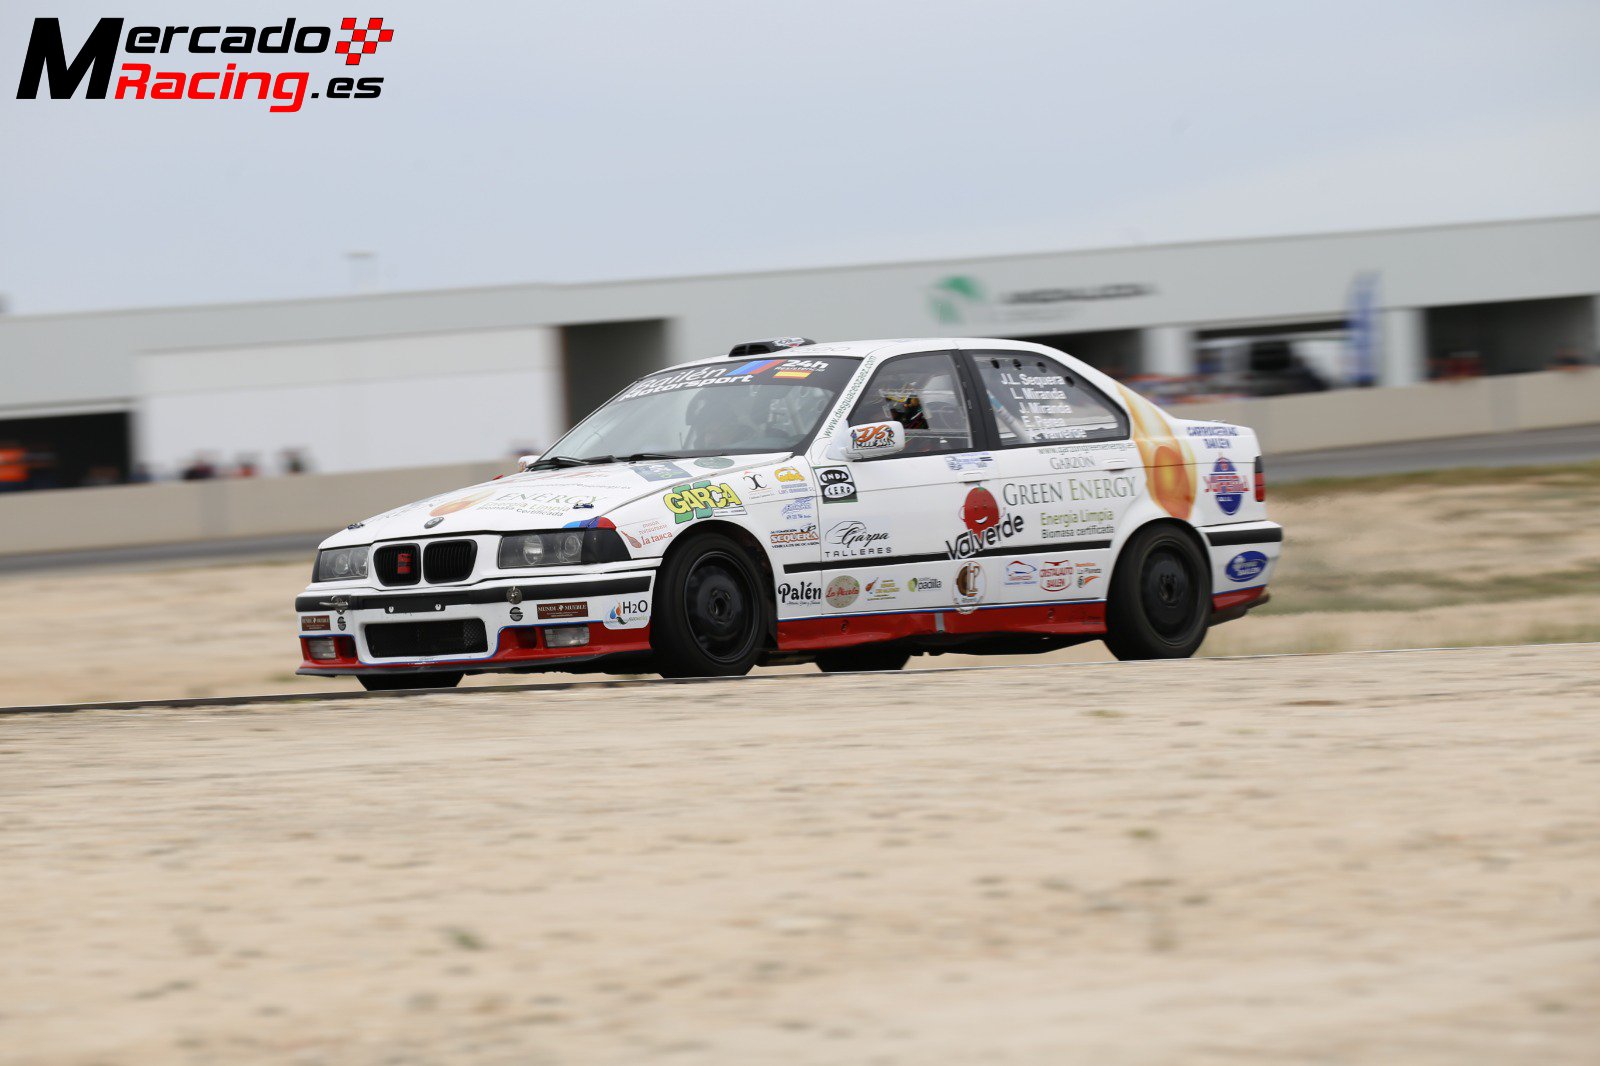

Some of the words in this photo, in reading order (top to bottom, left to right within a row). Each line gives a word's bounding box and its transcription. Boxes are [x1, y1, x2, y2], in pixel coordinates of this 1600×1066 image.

[1019, 374, 1065, 388] Sequera
[1021, 387, 1067, 400] Miranda
[820, 470, 850, 483] ONDA
[1003, 482, 1063, 506] GREEN
[1068, 477, 1136, 501] ENERGY
[770, 532, 820, 545] SEQUERA
[945, 512, 1026, 561] Valverde
[824, 547, 892, 558] TALLERES
[777, 581, 822, 604] Palén
[622, 600, 648, 614] H2O
